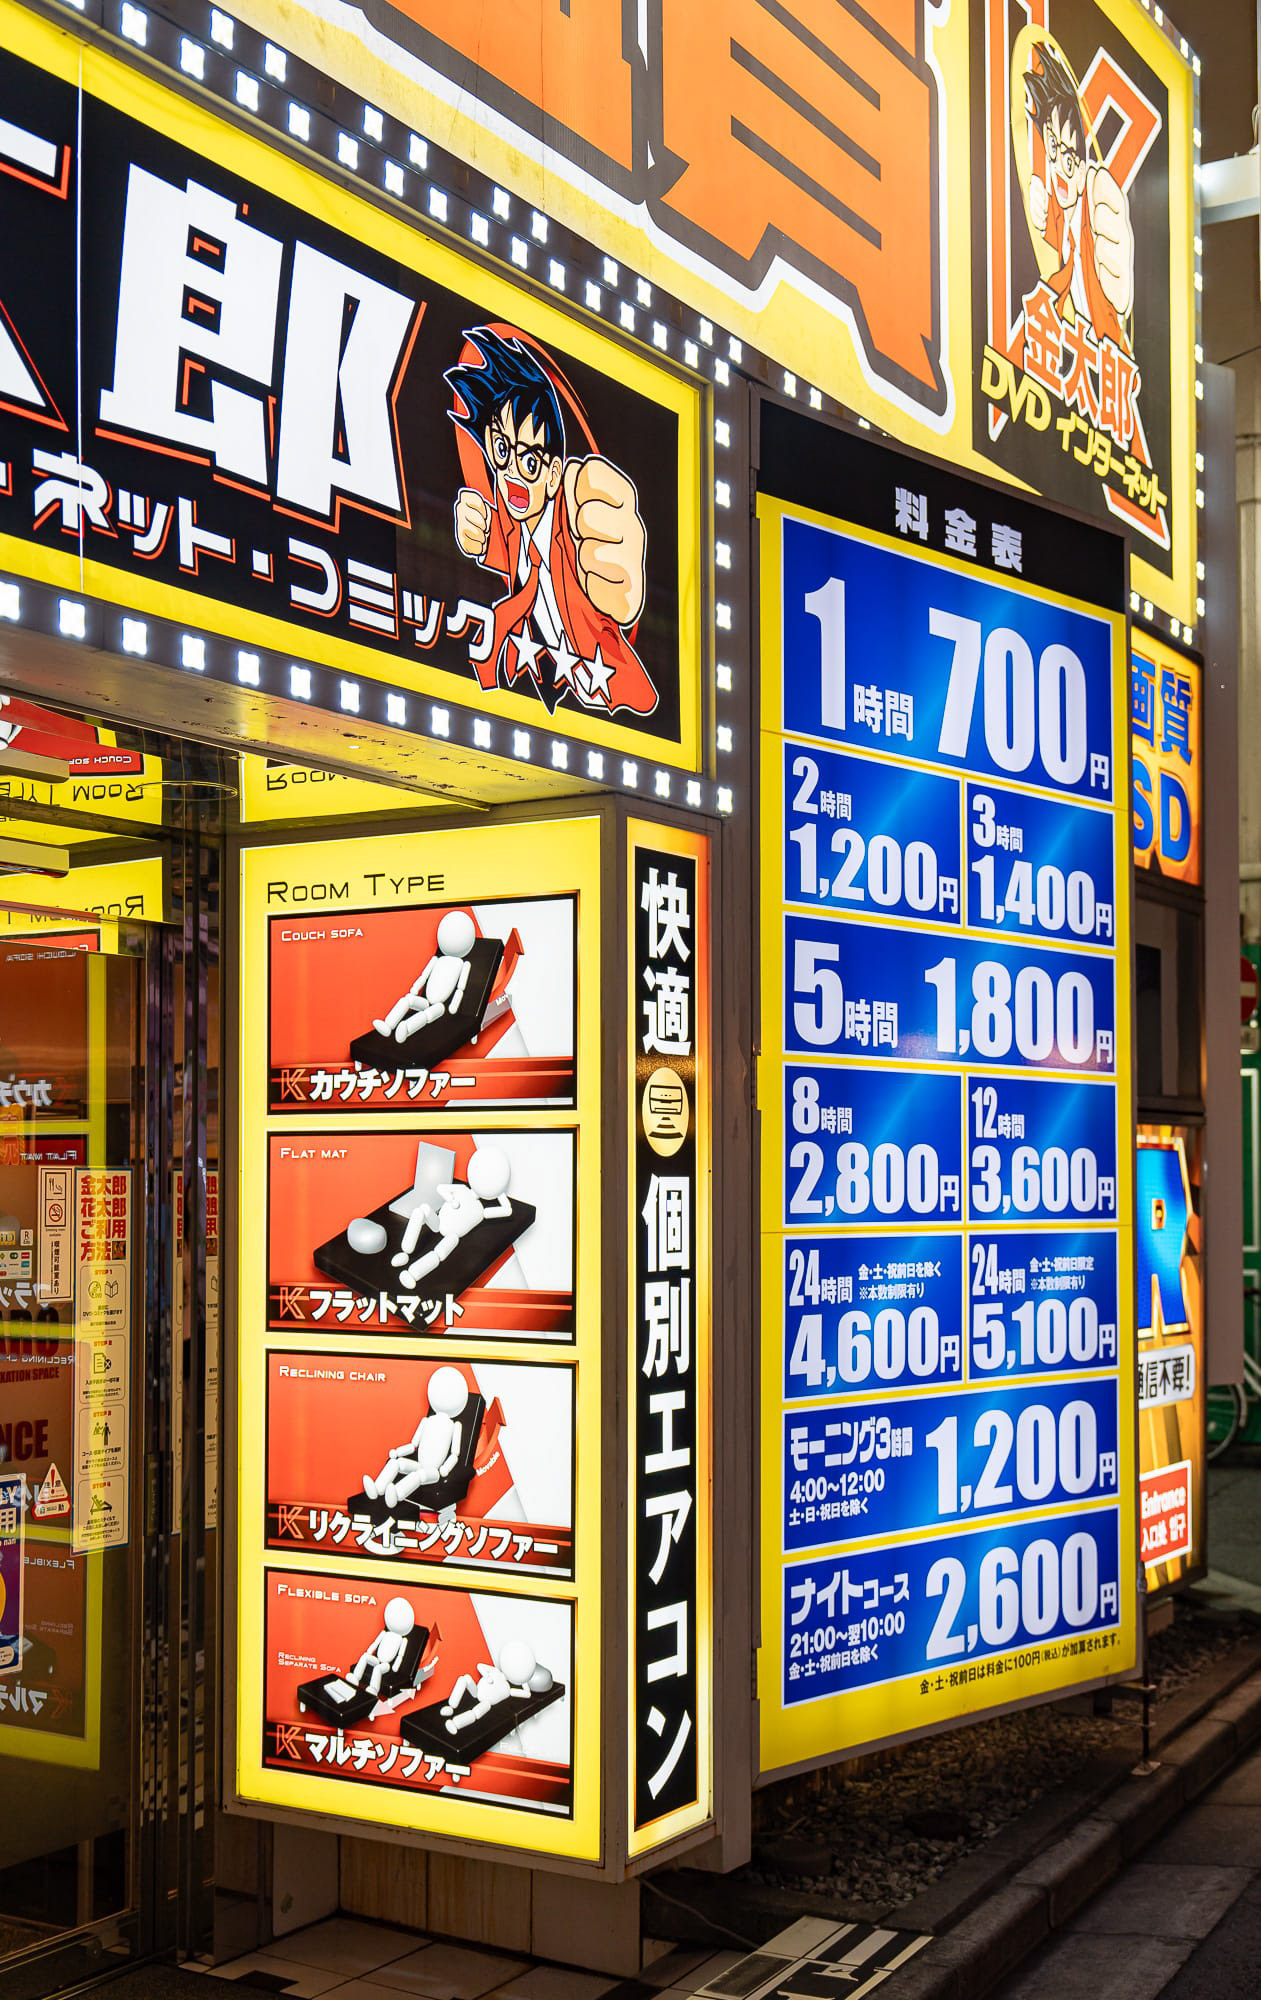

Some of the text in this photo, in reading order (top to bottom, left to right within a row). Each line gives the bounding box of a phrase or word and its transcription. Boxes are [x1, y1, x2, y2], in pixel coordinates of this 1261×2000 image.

[1022, 281, 1139, 448] 金太郎
[981, 345, 1167, 515] DVD インターネット
[0, 446, 500, 663] ネット・コミック
[894, 486, 1023, 573] 料金表
[804, 577, 1110, 790] 1時間 700円
[792, 757, 852, 822] 2時間
[972, 794, 1024, 853] 3時間
[789, 822, 959, 914] 1,200円
[971, 853, 1113, 938] 1,400円
[281, 927, 364, 942] COUCH SOFA
[793, 939, 1114, 1065] 5時間 1,800円
[309, 1069, 477, 1102] カウチソファー
[792, 1076, 853, 1135] 8時間
[971, 1086, 1026, 1140] 12時間
[280, 1147, 348, 1159] FLAT MAT
[789, 1140, 960, 1217] 2,800円
[971, 1144, 1115, 1215] 3,600円
[80, 1174, 127, 1195] 金太郎
[80, 1197, 127, 1217] 花太郎
[80, 1219, 127, 1239] ご利用
[80, 1240, 112, 1262] 方法
[789, 1248, 853, 1307] 24時間
[971, 1243, 1026, 1297] 24時間
[309, 1290, 465, 1327] フラットマット
[640, 866, 694, 1801] 快適 個別エアコン
[971, 1297, 1116, 1371] 5,100円
[278, 1365, 387, 1382] RECLINING CHAIR
[789, 1305, 961, 1388] 4,600円
[925, 1399, 1117, 1516] 1,200円
[308, 1508, 560, 1562] リクライニングソファー
[788, 1497, 869, 1526] 土・日・祝日を除く
[277, 1584, 378, 1606] FLEXIBLE SOFA
[790, 1569, 910, 1626] ナイトコース
[924, 1531, 1119, 1662] 2,600円
[788, 1643, 879, 1681] 金・土・祝前日を除く
[305, 1732, 471, 1782] マルチソファー
